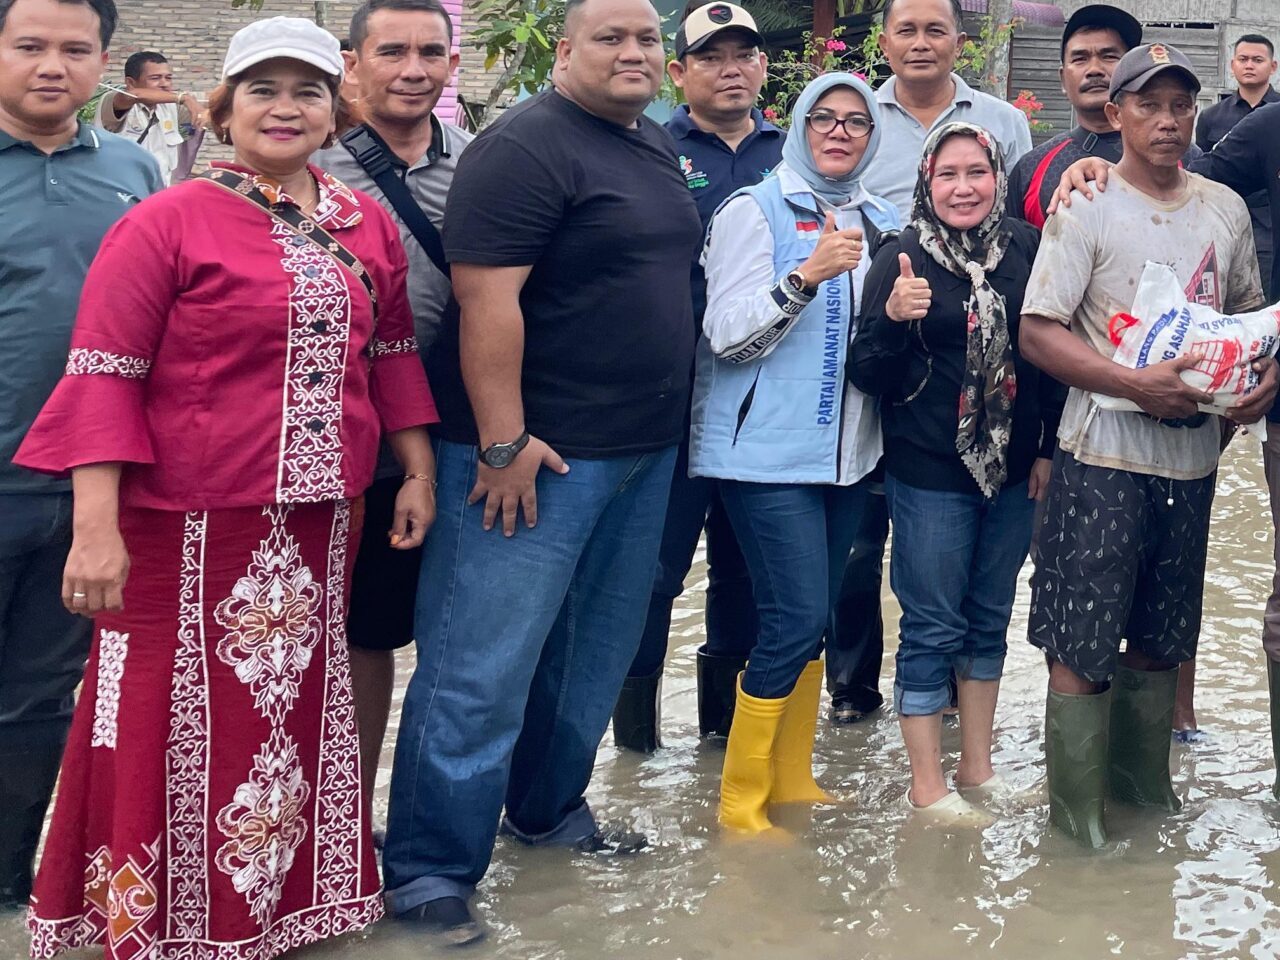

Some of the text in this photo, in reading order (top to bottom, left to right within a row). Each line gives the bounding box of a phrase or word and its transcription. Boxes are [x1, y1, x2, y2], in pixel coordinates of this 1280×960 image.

[726, 327, 781, 363] TIAN DIOR
[1168, 307, 1192, 351] ASAHAN
[822, 327, 840, 379] AMANAT
[817, 380, 836, 425] PARTAI
